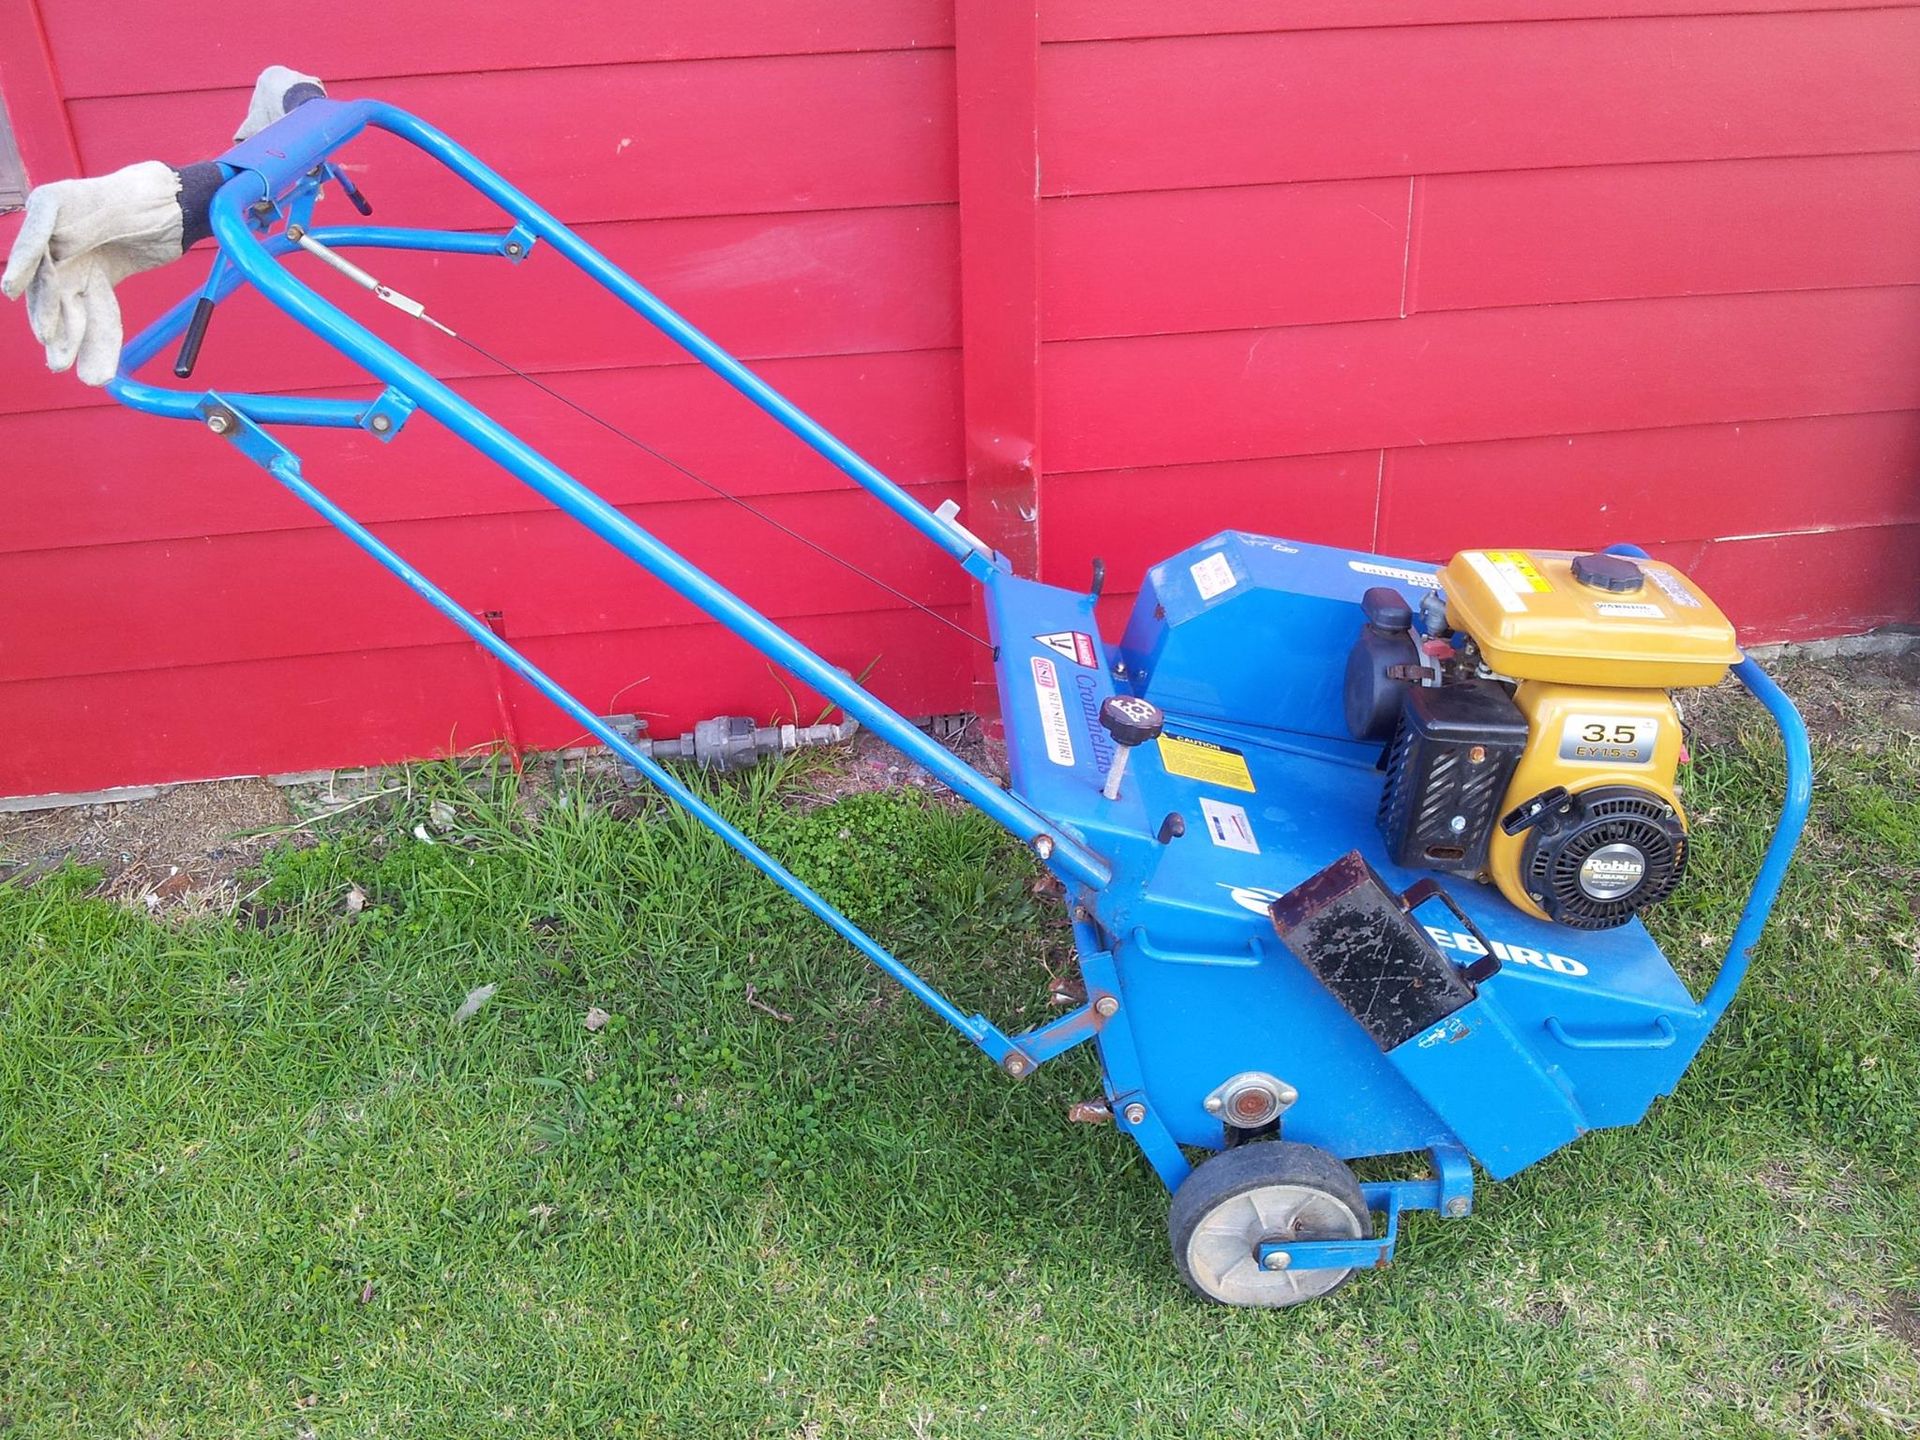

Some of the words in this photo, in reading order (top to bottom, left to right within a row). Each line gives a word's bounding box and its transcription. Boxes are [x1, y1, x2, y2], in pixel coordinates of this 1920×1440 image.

[1075, 674, 1115, 774] Crommelins
[1582, 724, 1636, 744] 3.5
[1176, 735, 1221, 751] CAUTION
[1576, 746, 1638, 758] EY15-3
[1585, 859, 1643, 875] Robin
